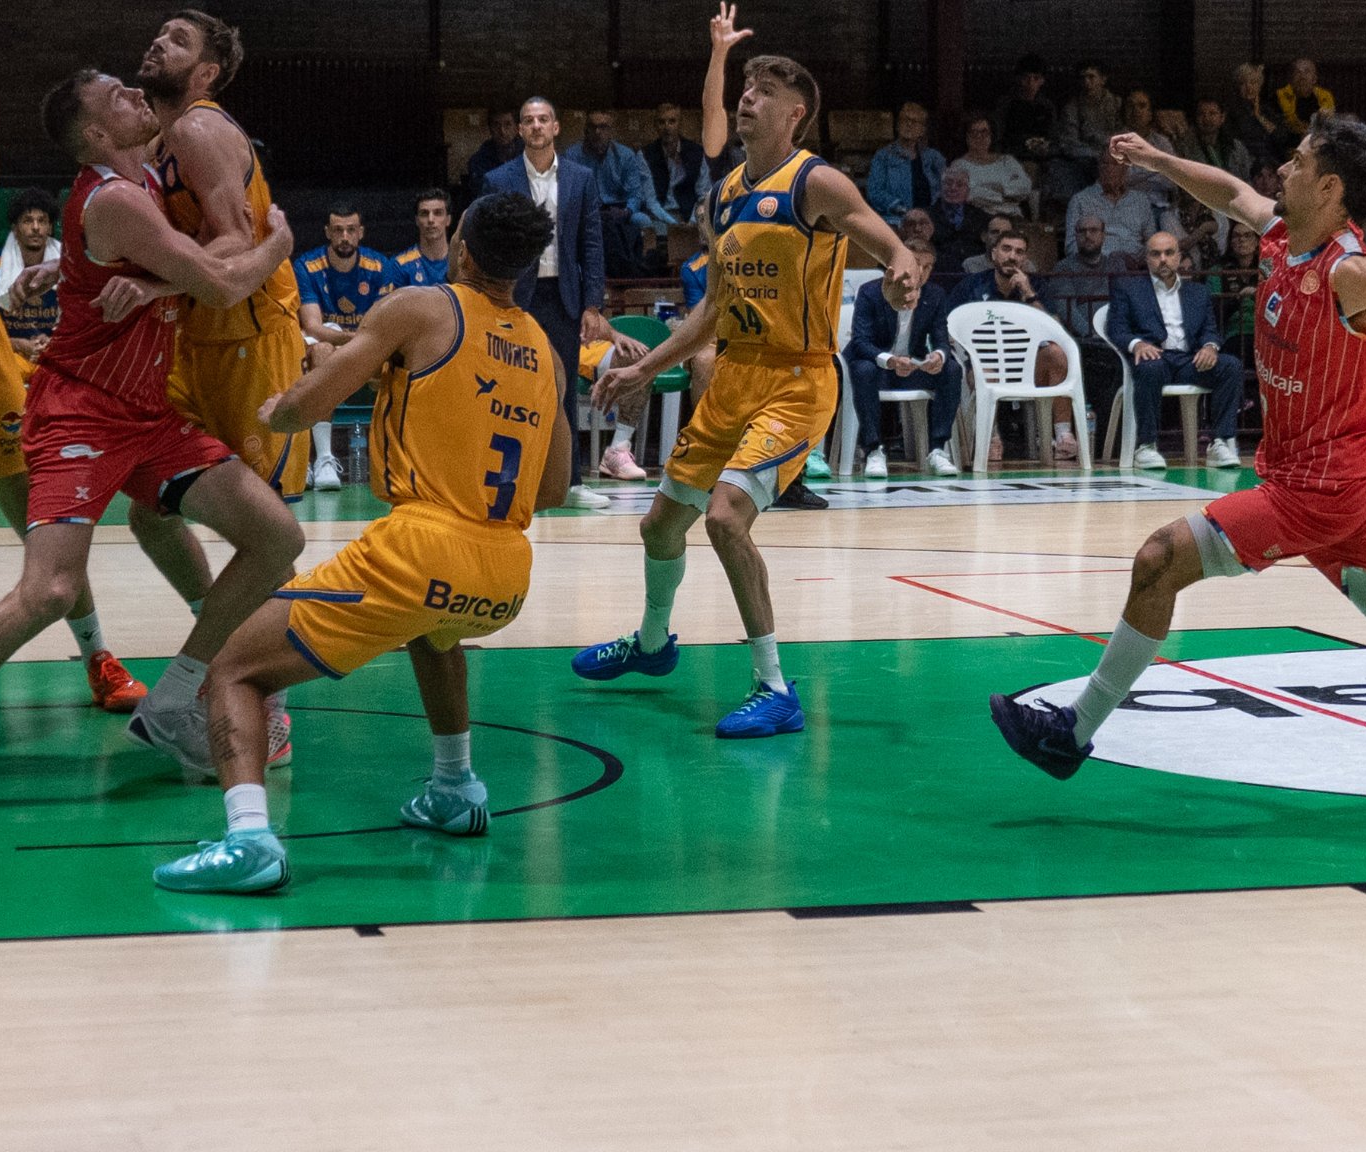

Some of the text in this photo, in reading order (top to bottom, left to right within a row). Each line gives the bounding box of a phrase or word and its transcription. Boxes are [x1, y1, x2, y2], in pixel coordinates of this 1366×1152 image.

[729, 304, 763, 335] 14
[485, 331, 538, 373] TOWNES
[484, 432, 522, 521] 3
